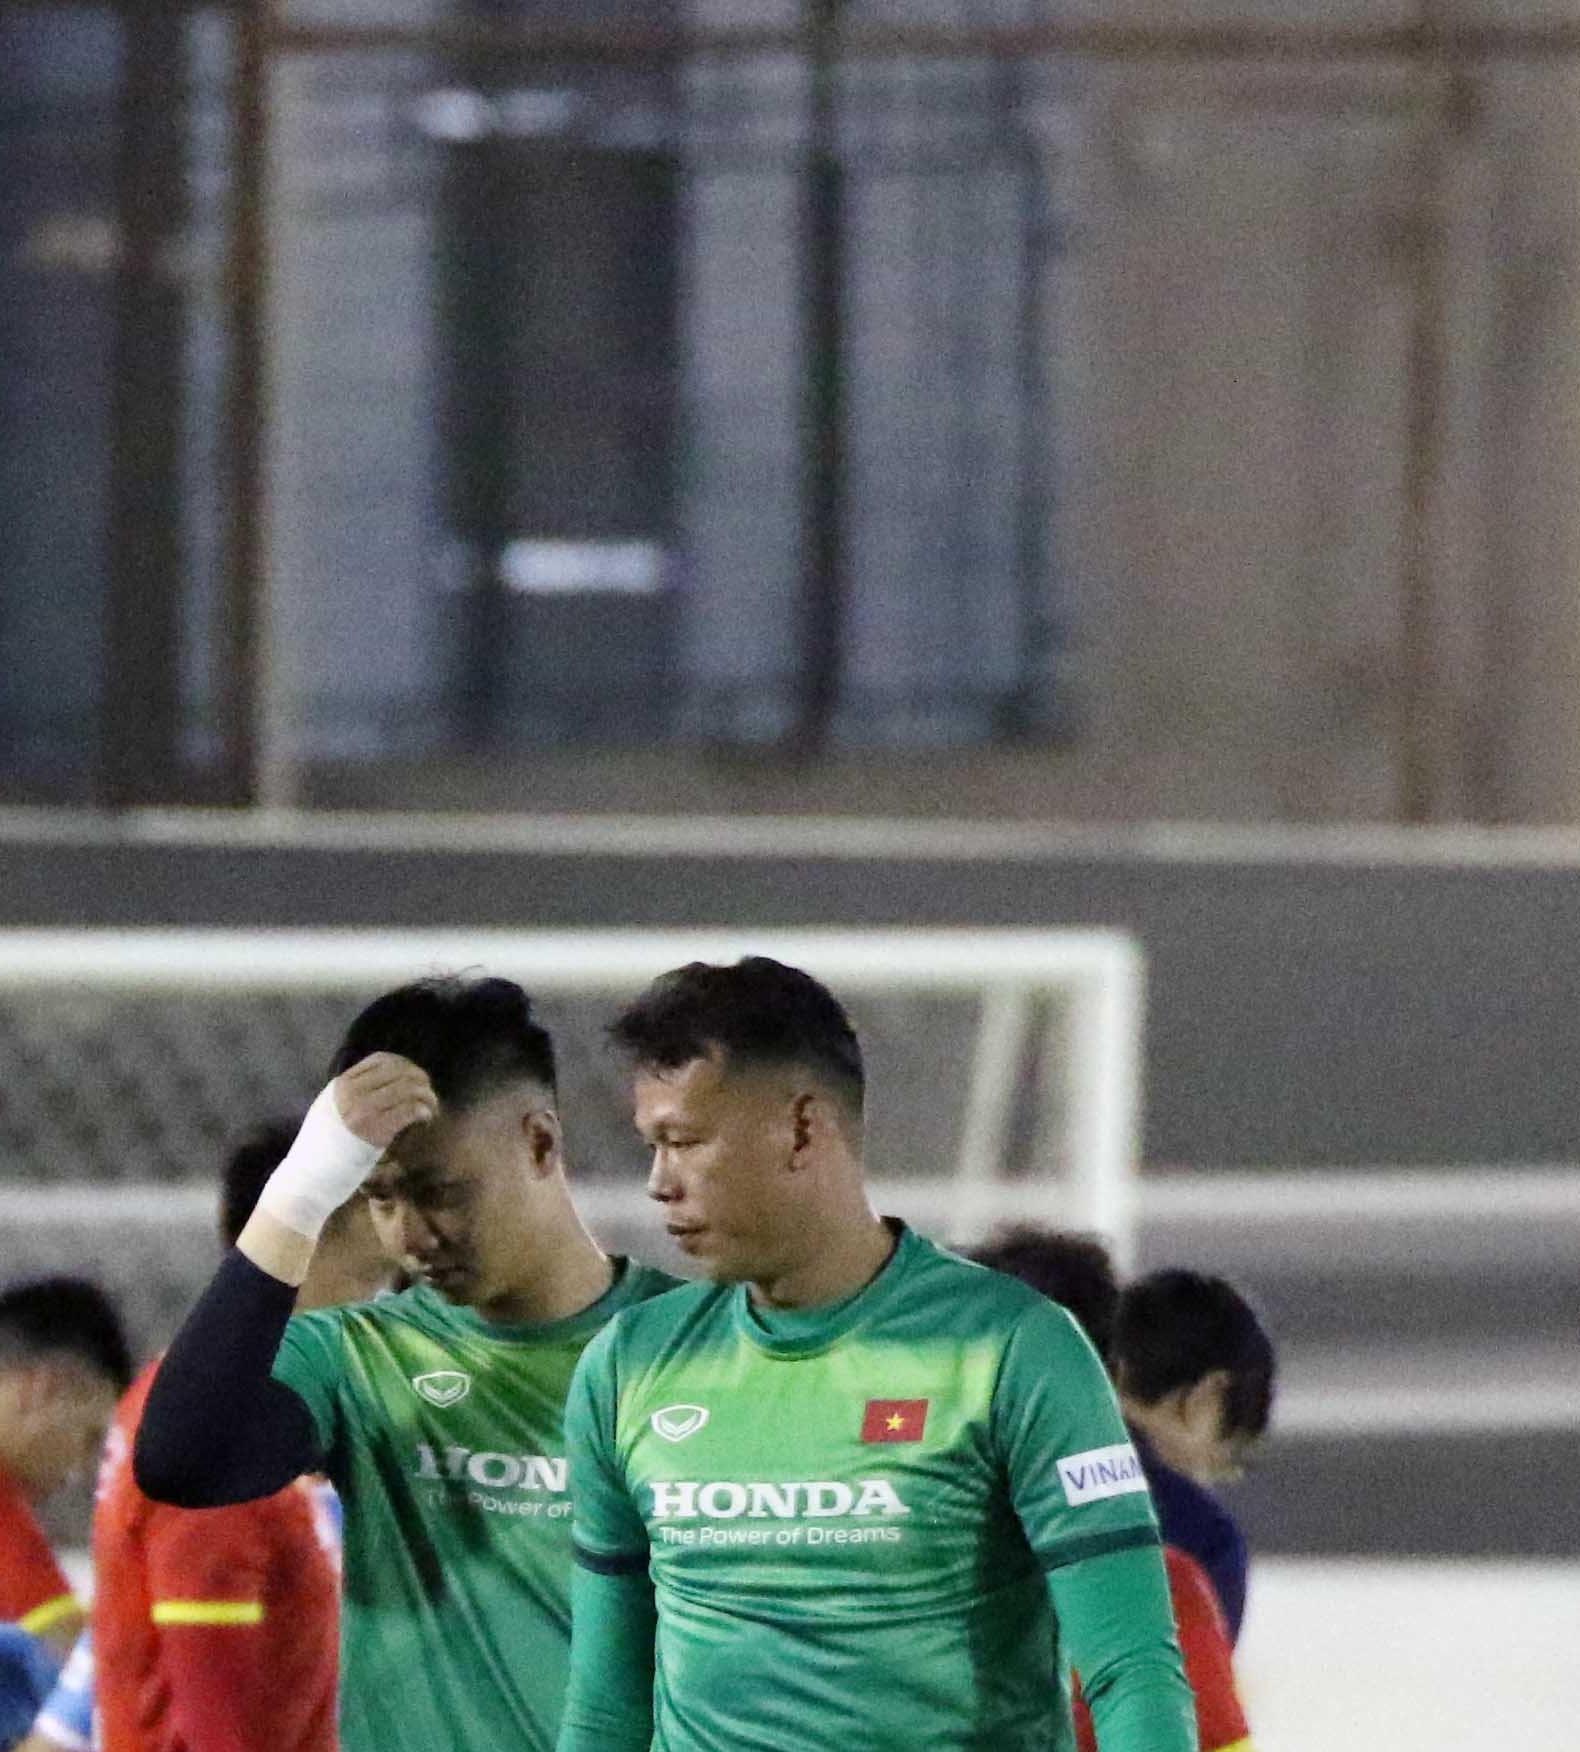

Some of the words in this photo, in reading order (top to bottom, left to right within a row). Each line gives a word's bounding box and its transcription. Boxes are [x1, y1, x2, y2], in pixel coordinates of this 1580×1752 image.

[414, 1443, 567, 1492] HON
[548, 1501, 572, 1518] of
[649, 1480, 910, 1518] HONDA
[659, 1527, 695, 1545] The
[699, 1527, 771, 1545] Power
[776, 1527, 800, 1544] of
[807, 1526, 902, 1545] Dreams
